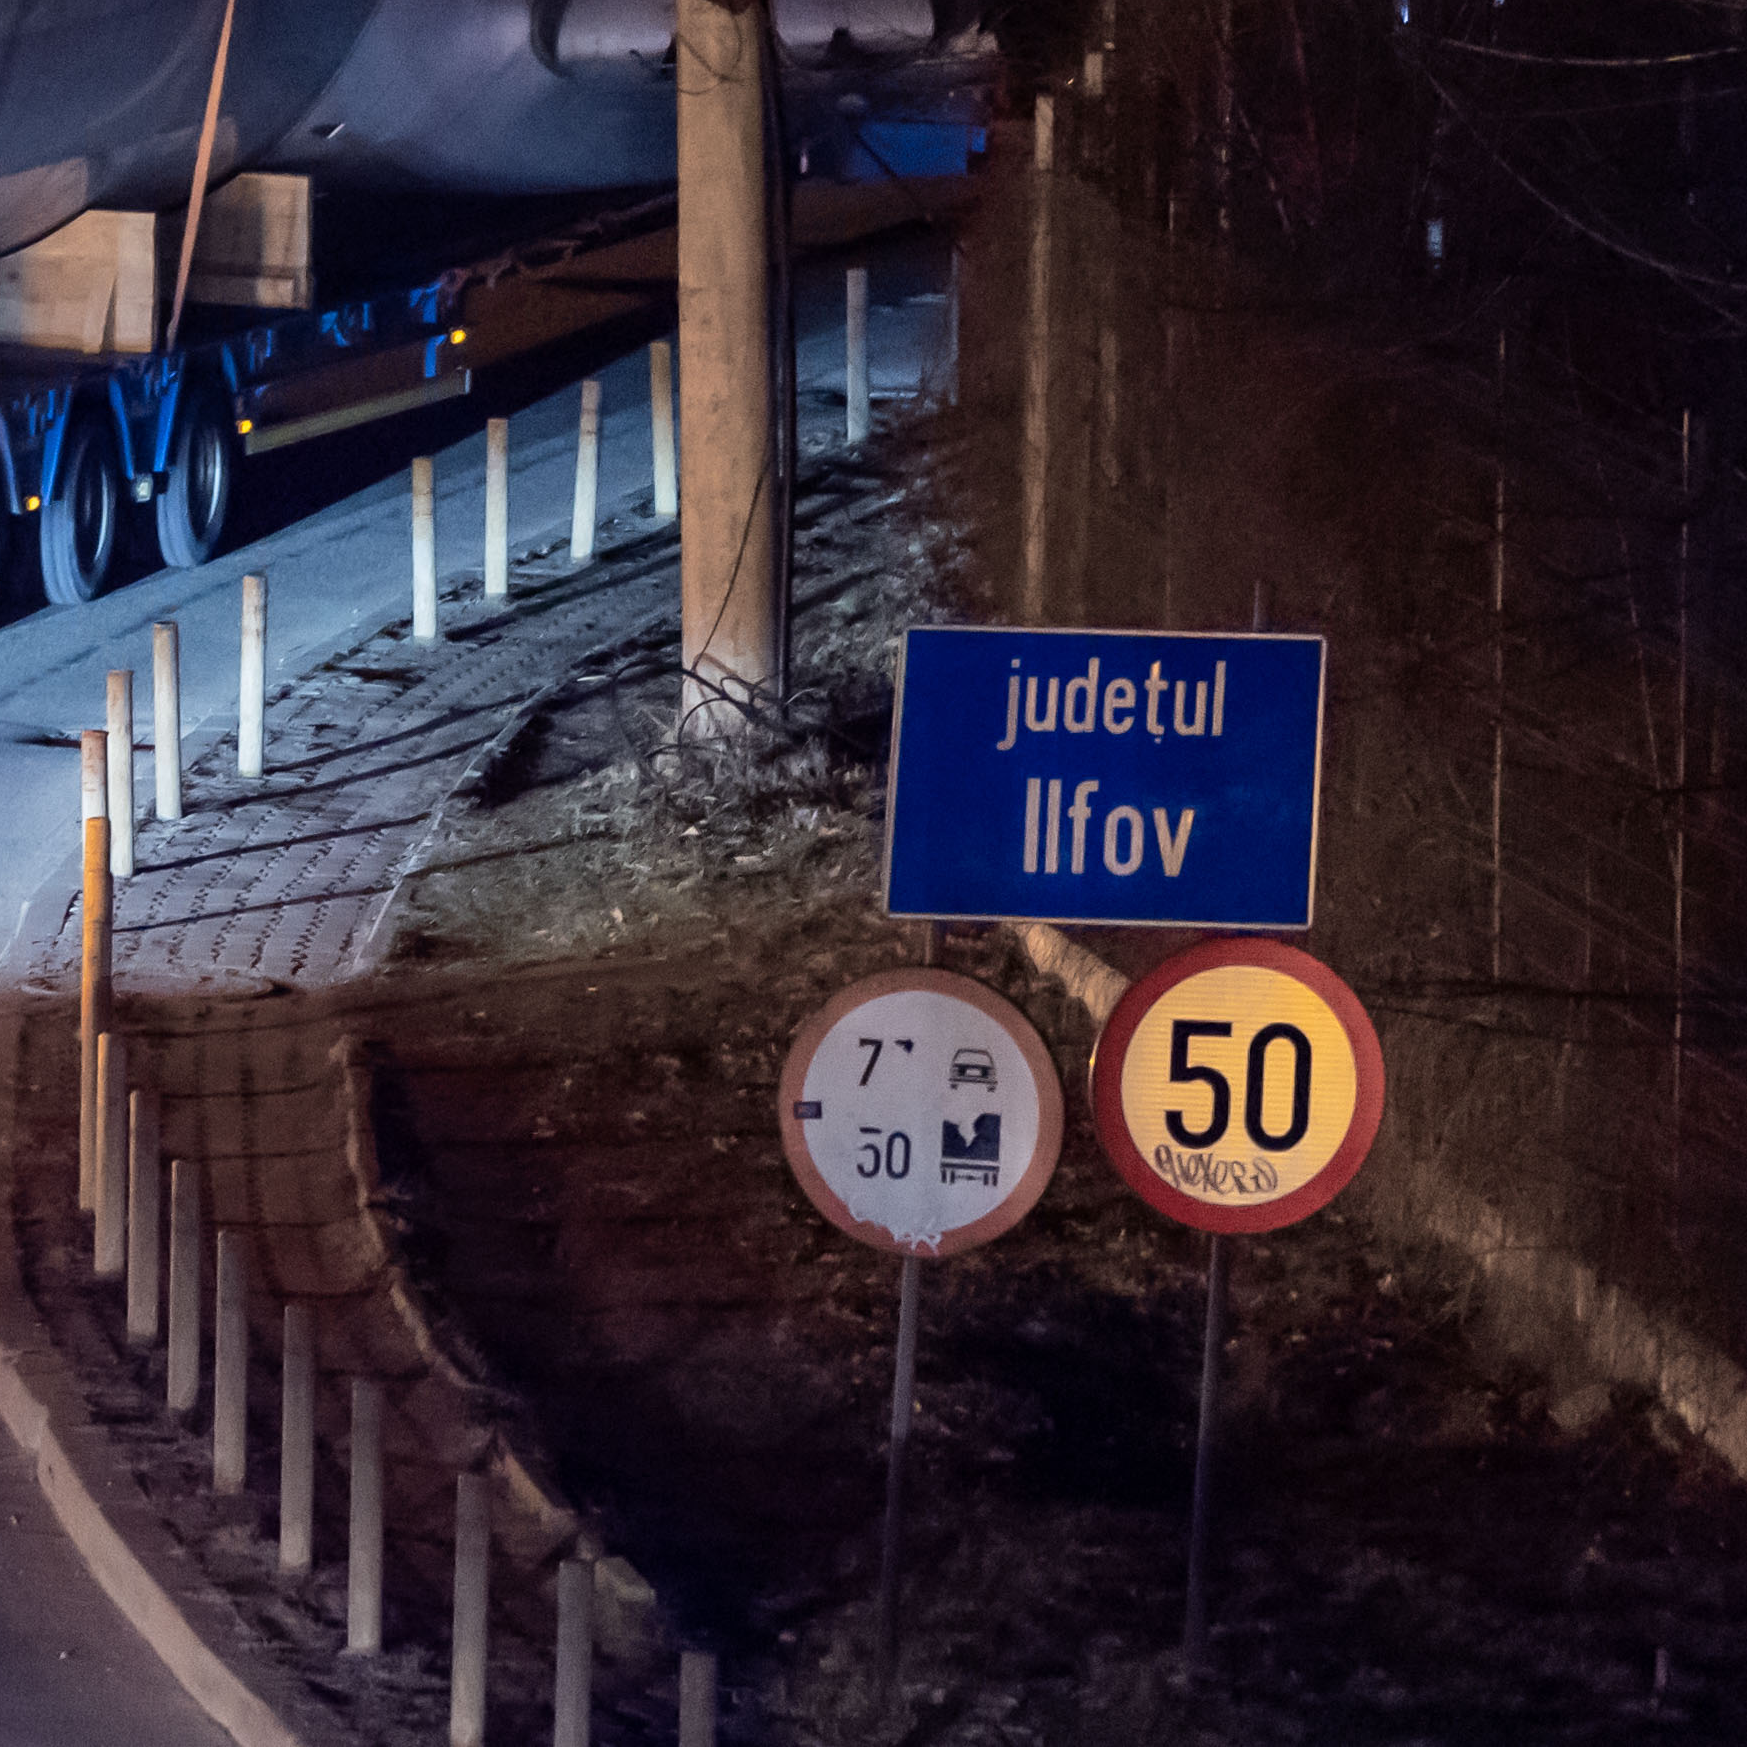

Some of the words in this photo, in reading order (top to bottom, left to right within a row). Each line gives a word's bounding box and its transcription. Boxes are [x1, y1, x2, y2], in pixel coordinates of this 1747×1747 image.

[996, 657, 1228, 752] județul
[1022, 777, 1197, 878] Ilfov
[1164, 1018, 1313, 1153] 50
